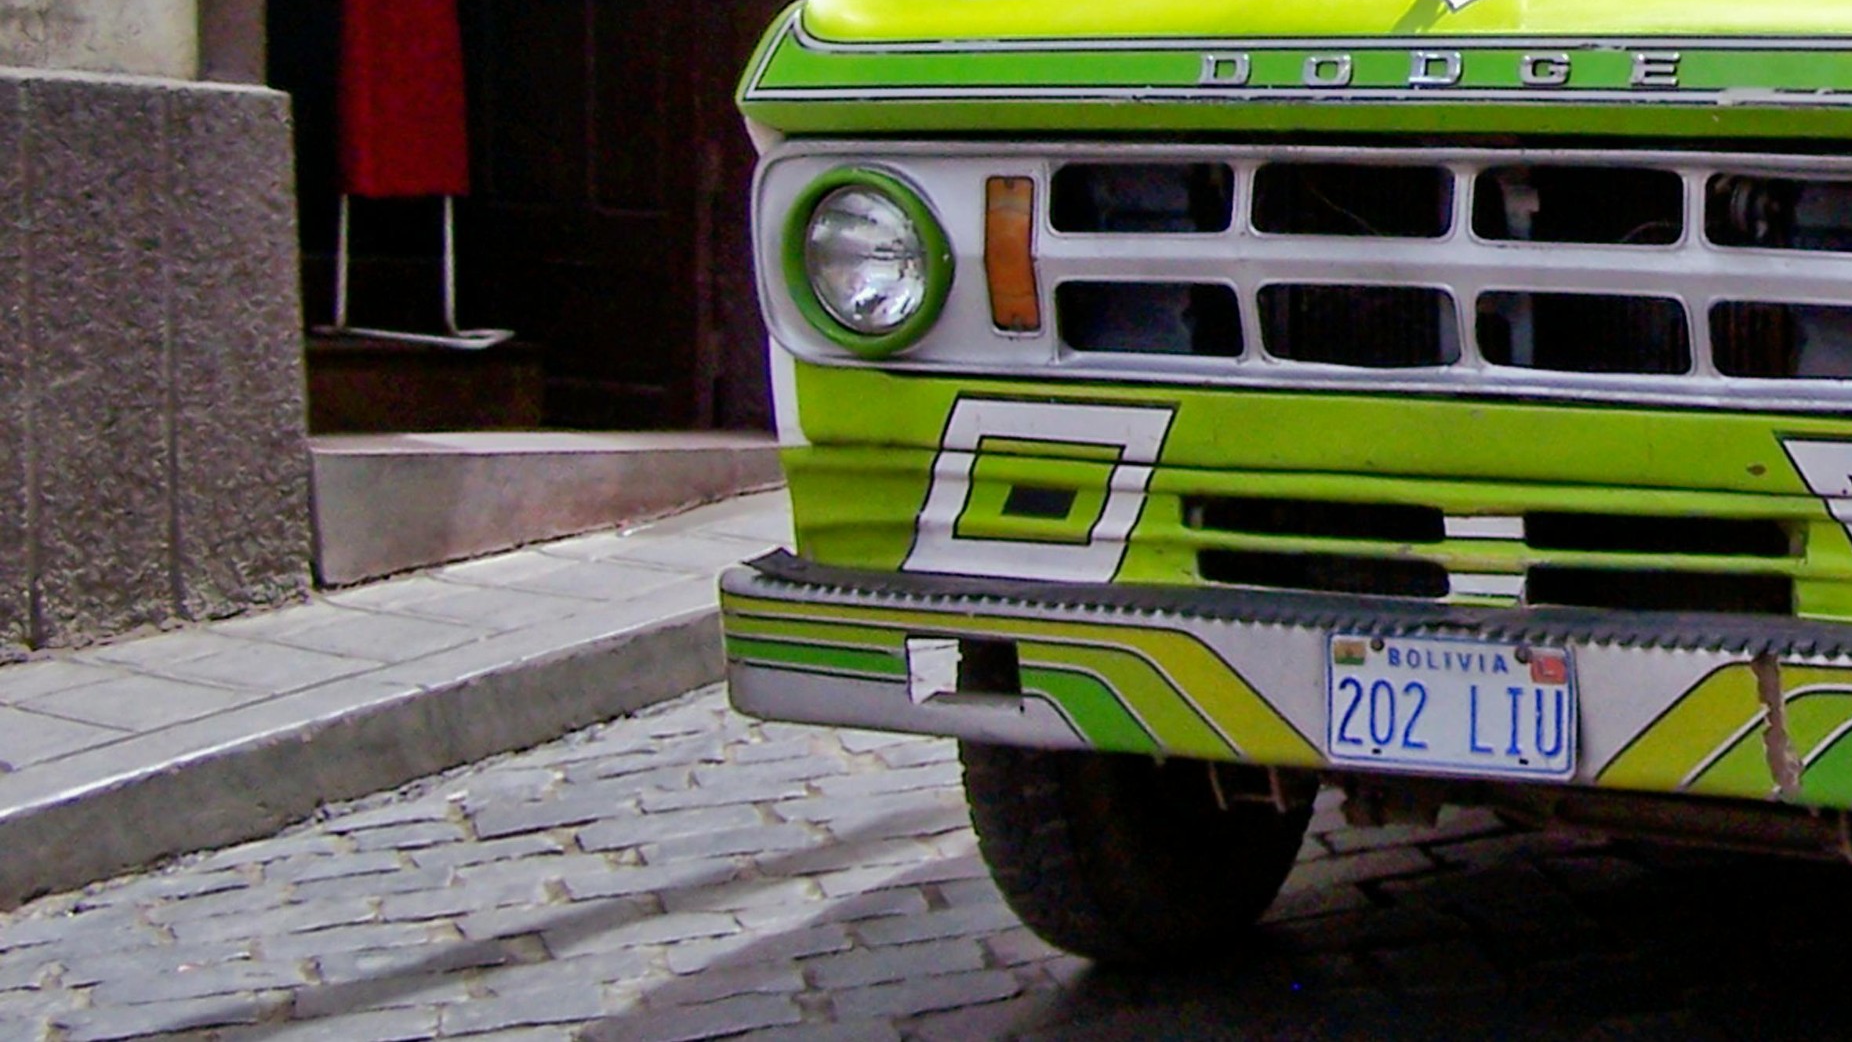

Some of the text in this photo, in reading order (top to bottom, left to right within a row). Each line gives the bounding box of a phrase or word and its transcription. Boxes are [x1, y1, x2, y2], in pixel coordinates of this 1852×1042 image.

[1202, 49, 1682, 91] DODGE
[1388, 646, 1510, 675] BOLIVIA
[1337, 676, 1565, 757] 202 LIU
